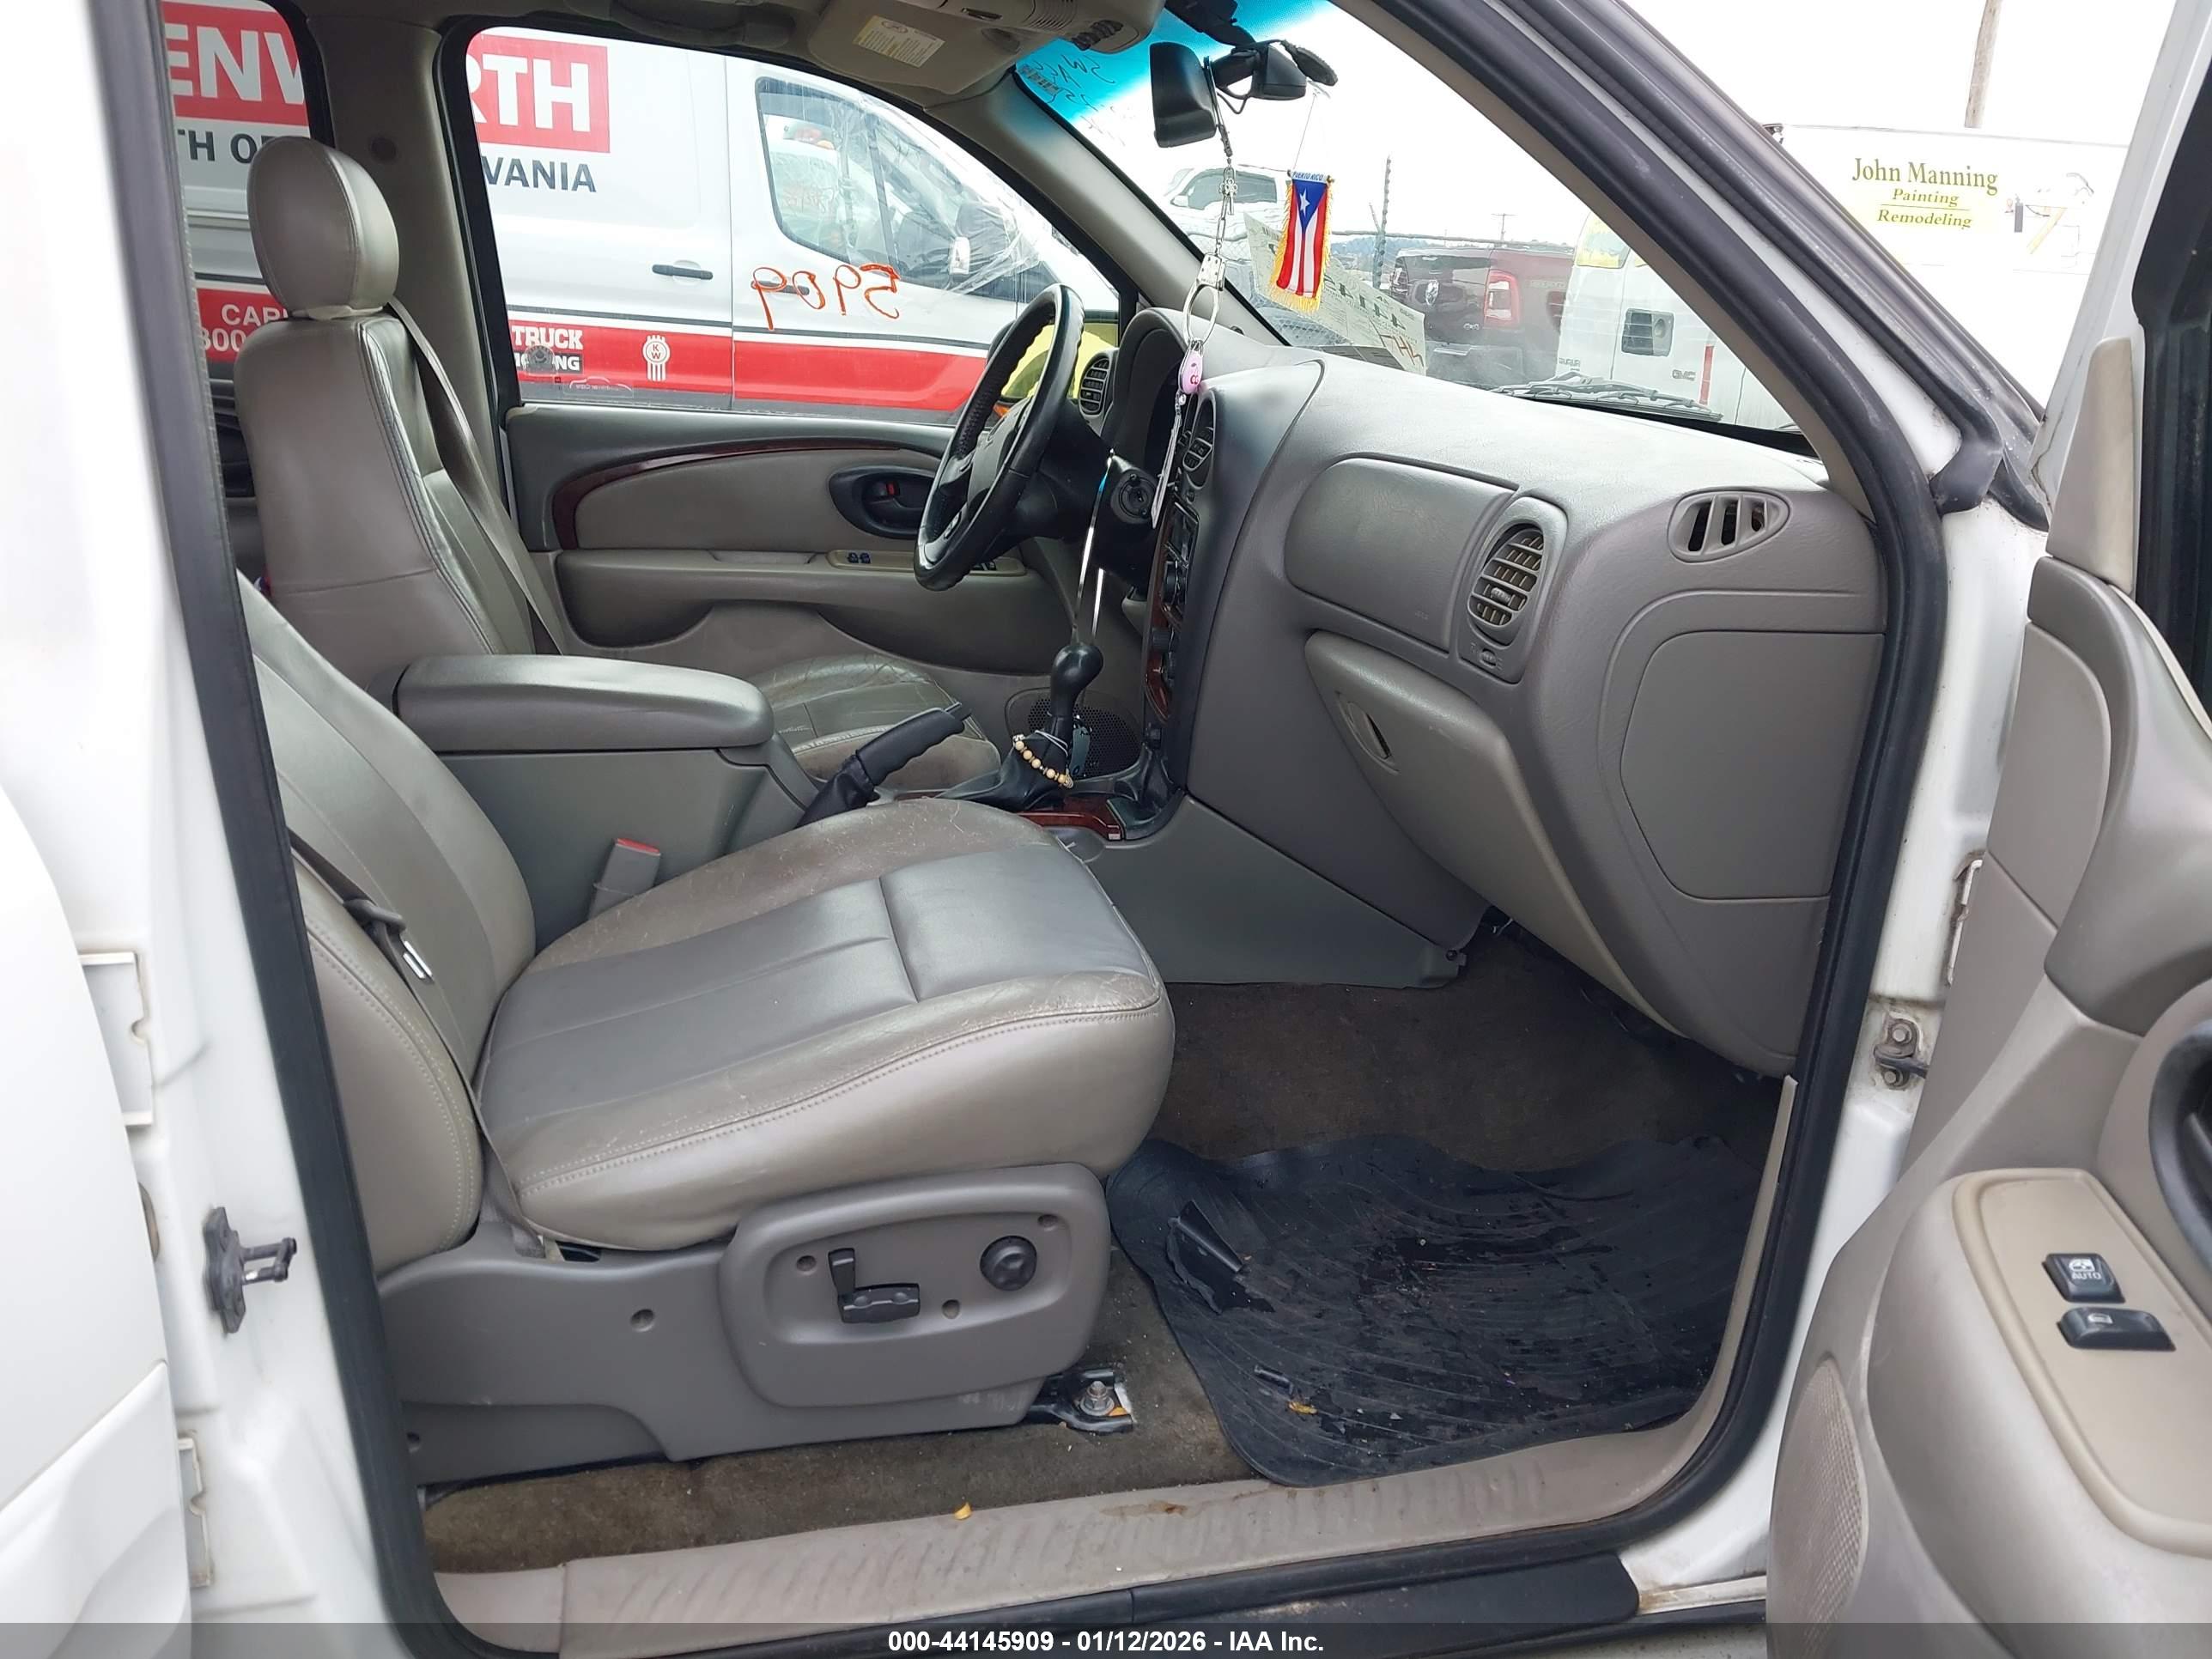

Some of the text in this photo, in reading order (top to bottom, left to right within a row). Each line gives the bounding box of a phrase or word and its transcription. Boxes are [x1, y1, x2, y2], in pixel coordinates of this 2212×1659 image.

[178, 130, 215, 161] H
[482, 155, 597, 192] VANIA
[1852, 157, 1998, 196] John Manning
[1893, 188, 1960, 207] Painting
[1877, 209, 1972, 229] Remodeling
[511, 325, 584, 350] TRUCK
[1672, 369, 1696, 381] GMC
